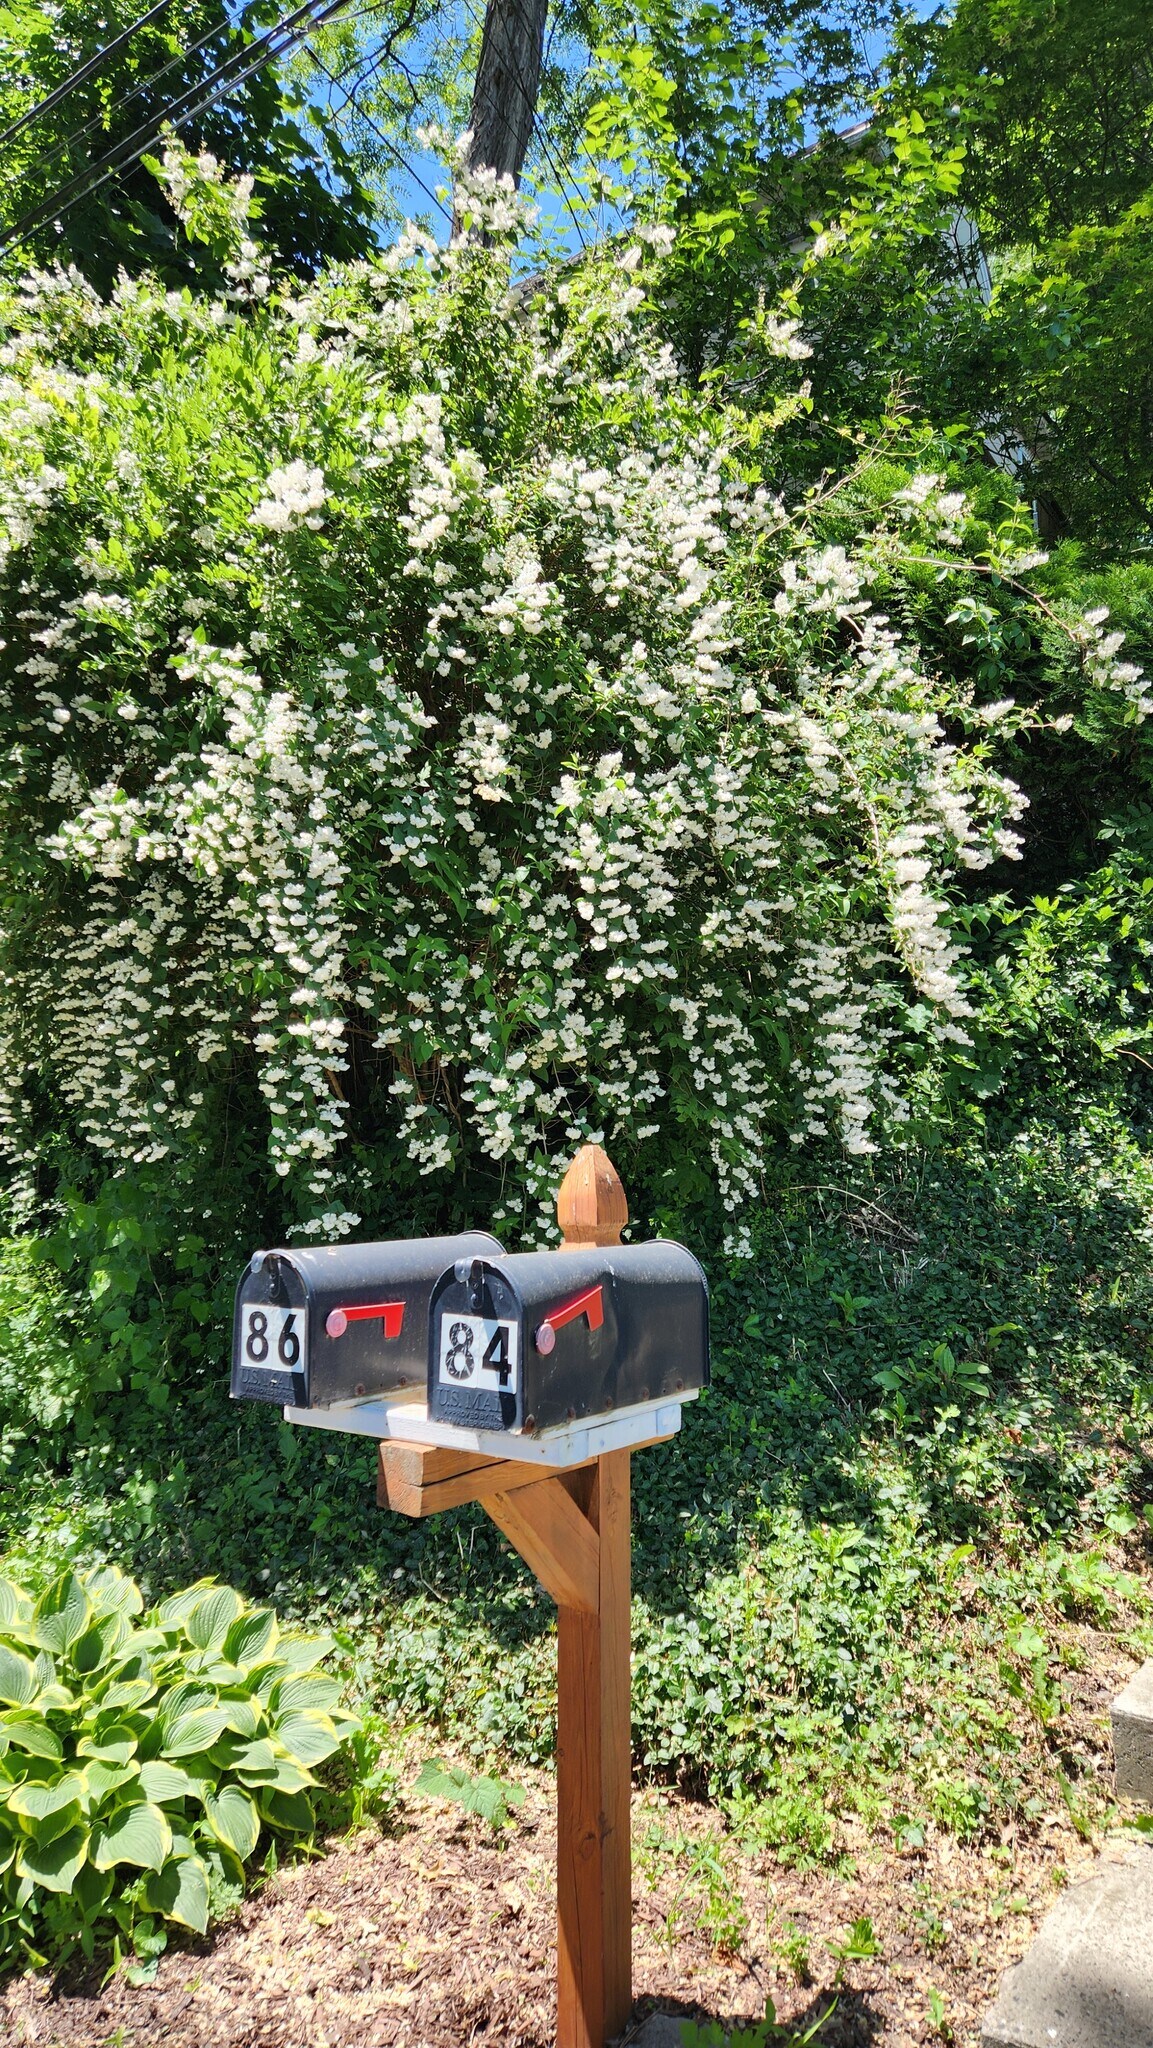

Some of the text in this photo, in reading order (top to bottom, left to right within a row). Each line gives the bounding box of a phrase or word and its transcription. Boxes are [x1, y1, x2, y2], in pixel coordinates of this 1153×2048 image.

[246, 1311, 300, 1367] 86
[445, 1322, 512, 1387] 84
[464, 1391, 502, 1413] MAI
